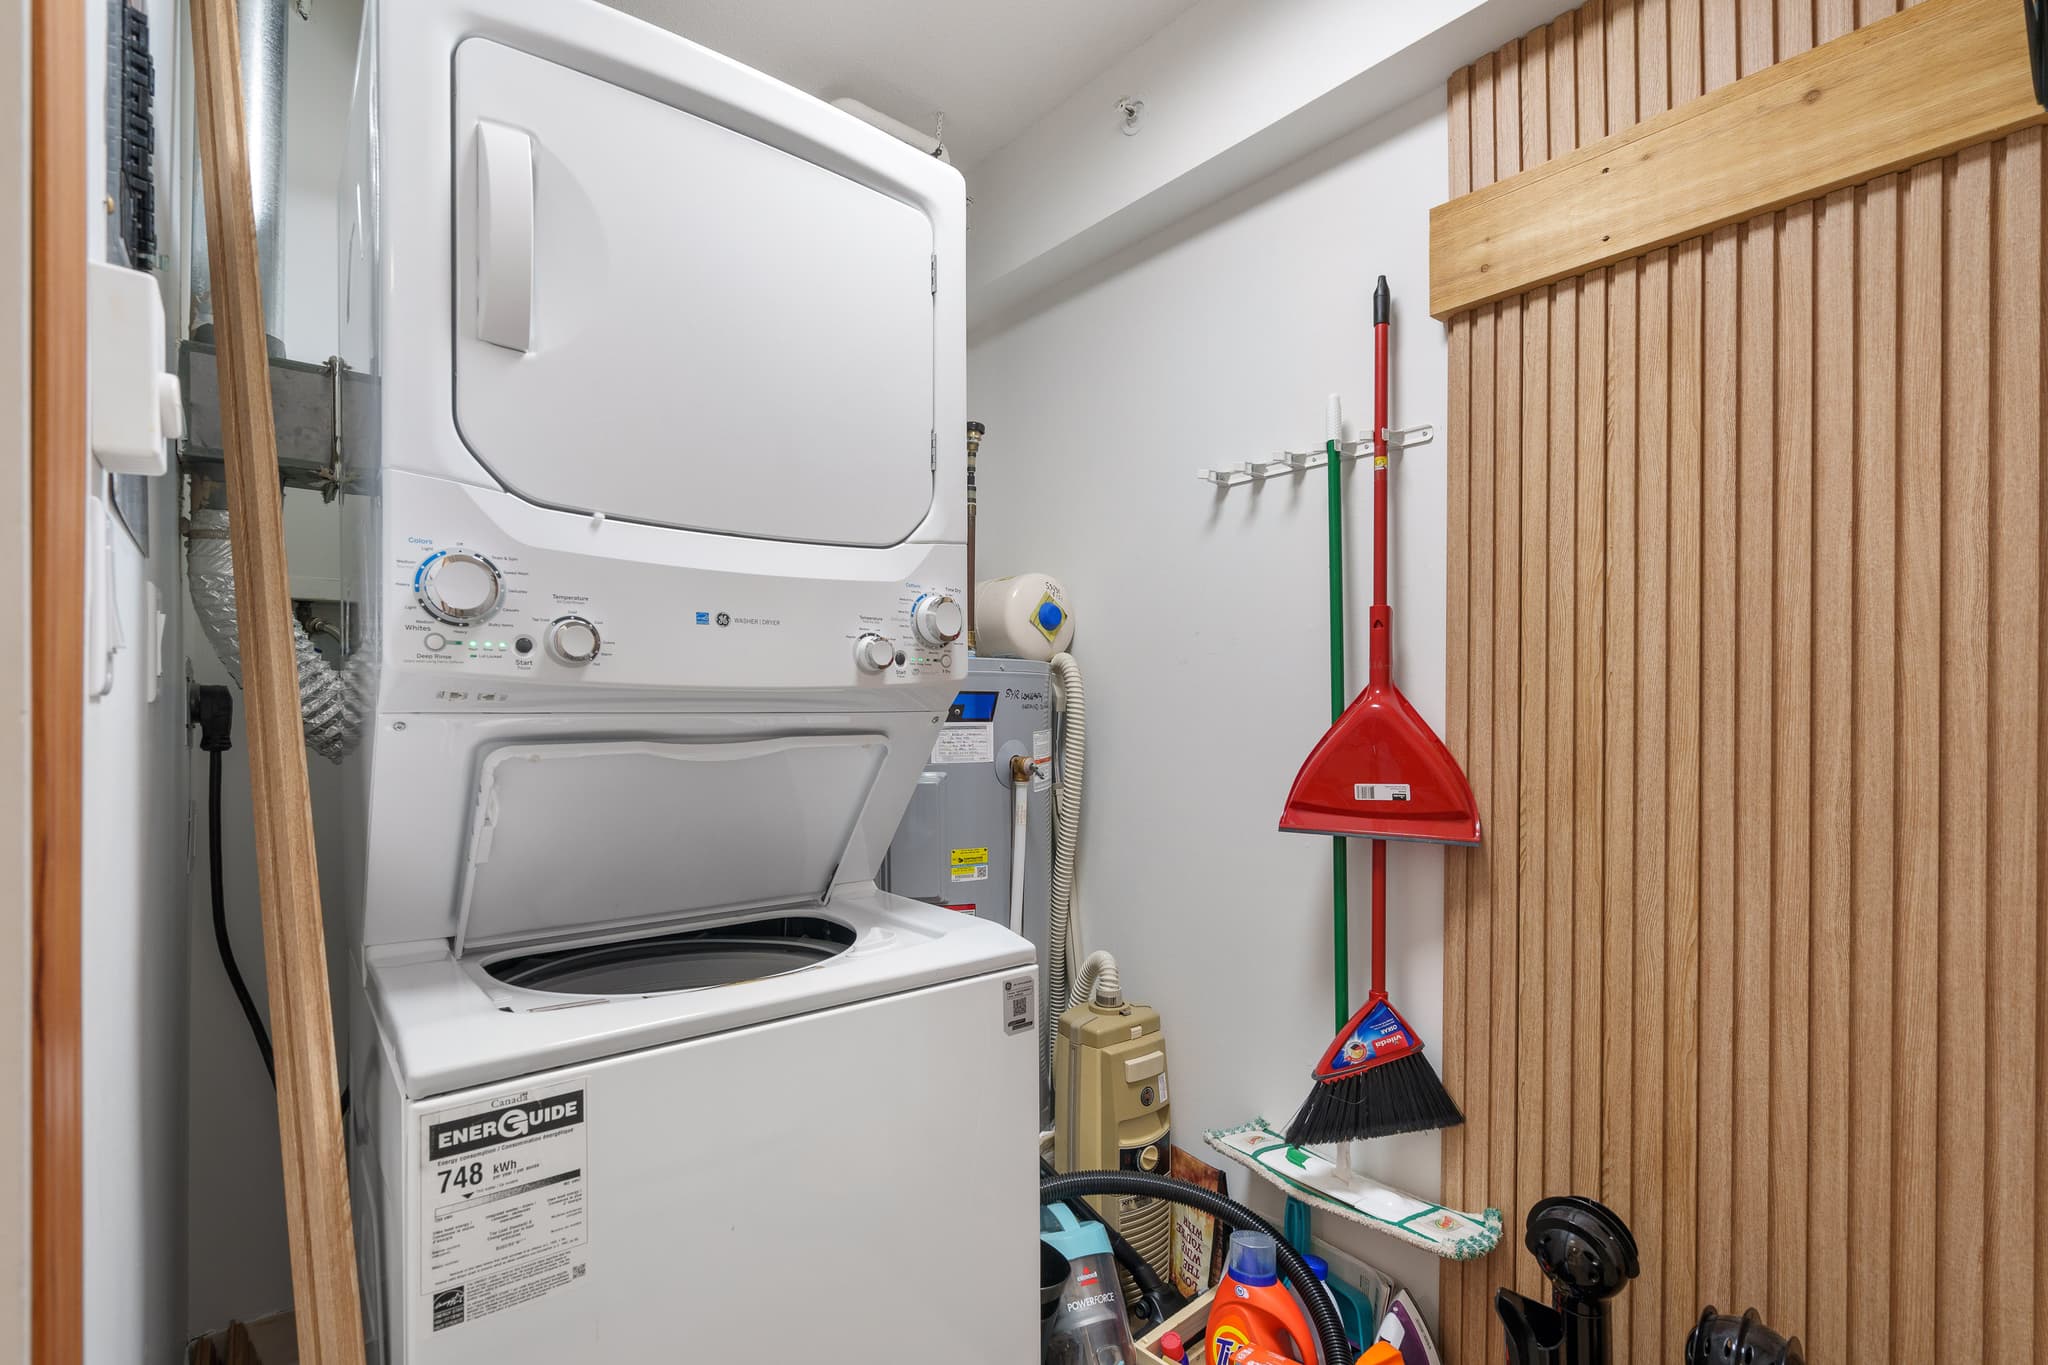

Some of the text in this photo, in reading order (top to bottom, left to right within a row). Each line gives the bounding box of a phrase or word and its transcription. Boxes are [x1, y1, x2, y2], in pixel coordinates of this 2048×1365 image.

[416, 653, 432, 661] Deep
[1381, 1025, 1398, 1035] OSKAR
[1375, 1035, 1402, 1047] vileda
[491, 1094, 528, 1108] Canada
[437, 1158, 458, 1167] Energy
[493, 1160, 517, 1174] kWh
[437, 1162, 483, 1194] 748
[1183, 1216, 1204, 1242] WITH
[1176, 1222, 1203, 1254] YOU'RE
[1181, 1241, 1202, 1267] WINE
[1182, 1258, 1200, 1280] THE
[1067, 1292, 1115, 1312] POWERFORCE
